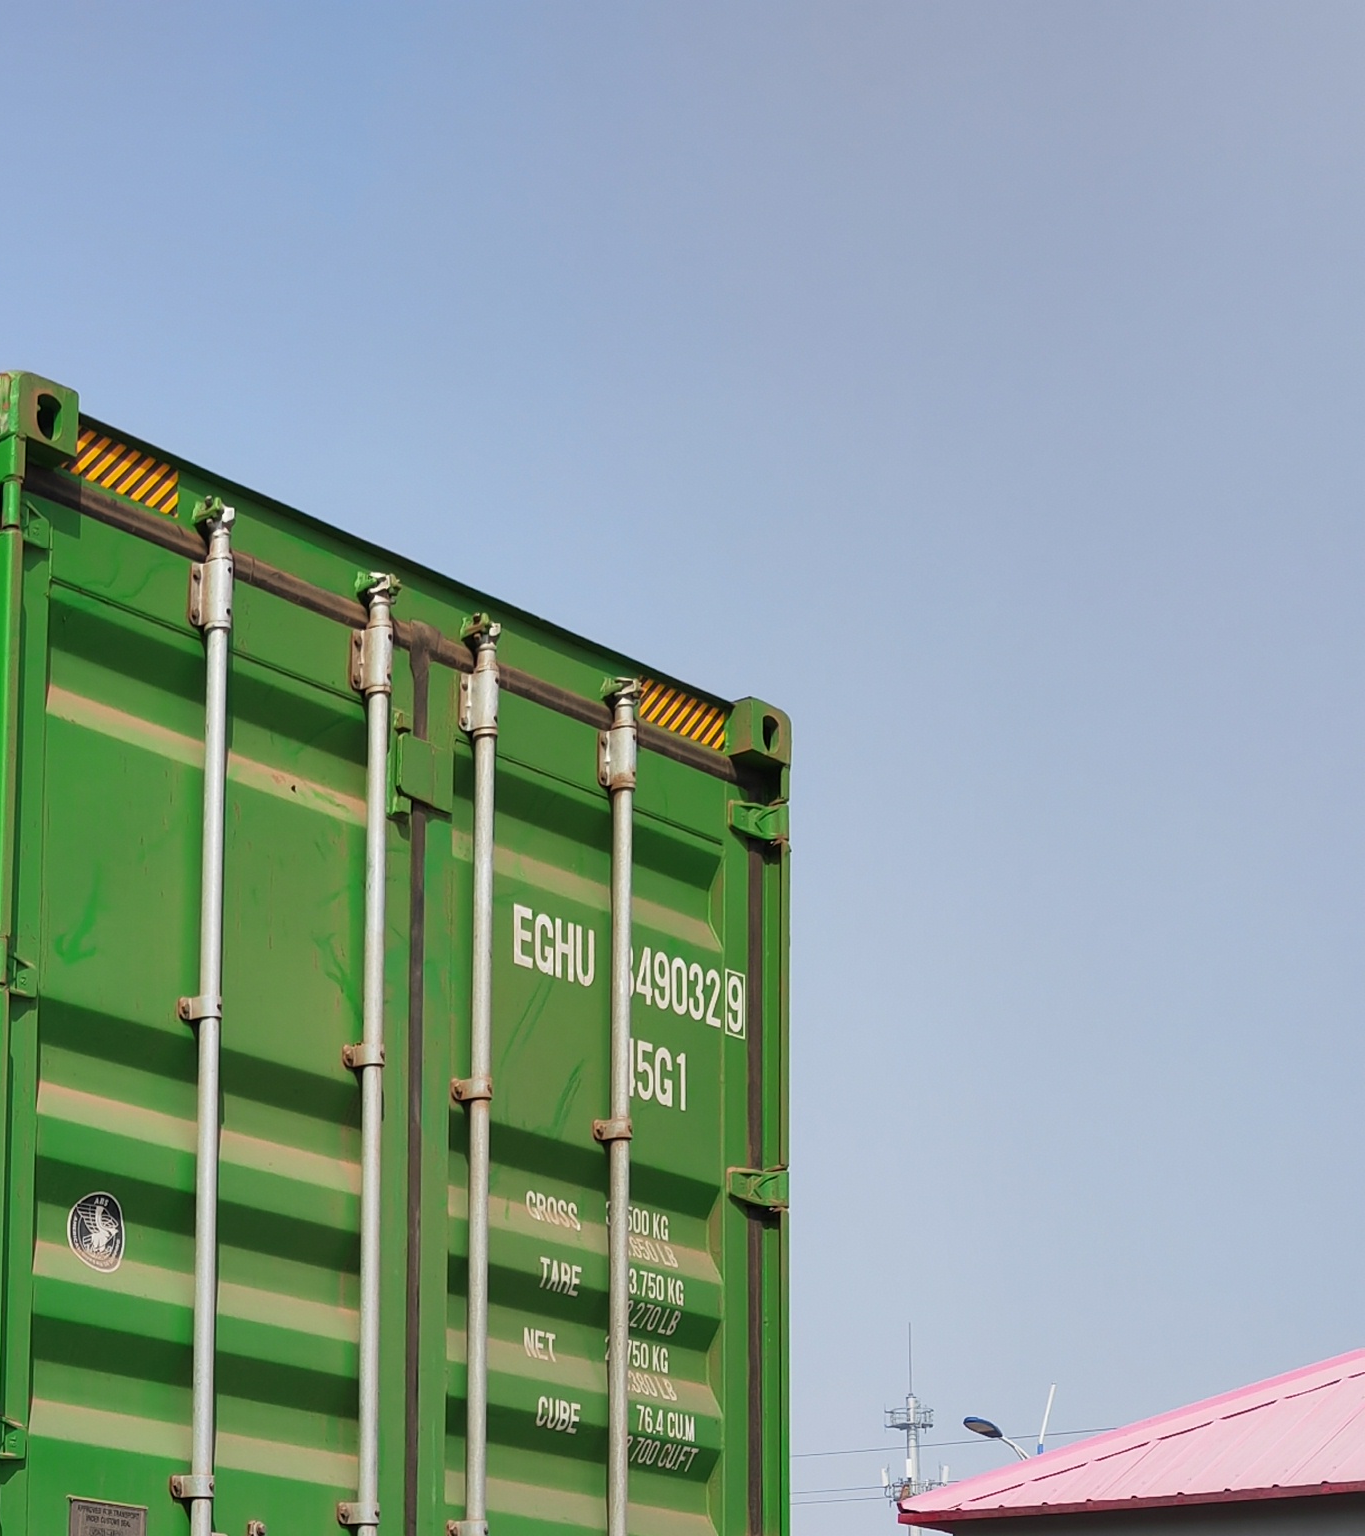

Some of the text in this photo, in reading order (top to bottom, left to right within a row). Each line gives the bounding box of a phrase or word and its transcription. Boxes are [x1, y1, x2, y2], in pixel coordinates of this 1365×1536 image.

[513, 903, 595, 987] EGHU
[526, 1190, 581, 1231] GROSS
[653, 1212, 669, 1242] KG
[656, 1243, 679, 1268] LB
[539, 1257, 582, 1297] TARE
[667, 1277, 684, 1306] KG
[658, 1308, 681, 1336] LB
[523, 1327, 556, 1362] NET
[653, 1346, 669, 1373] KG
[655, 1377, 677, 1401] LB
[535, 1396, 581, 1434] CUBE
[636, 1404, 664, 1435] 76.4
